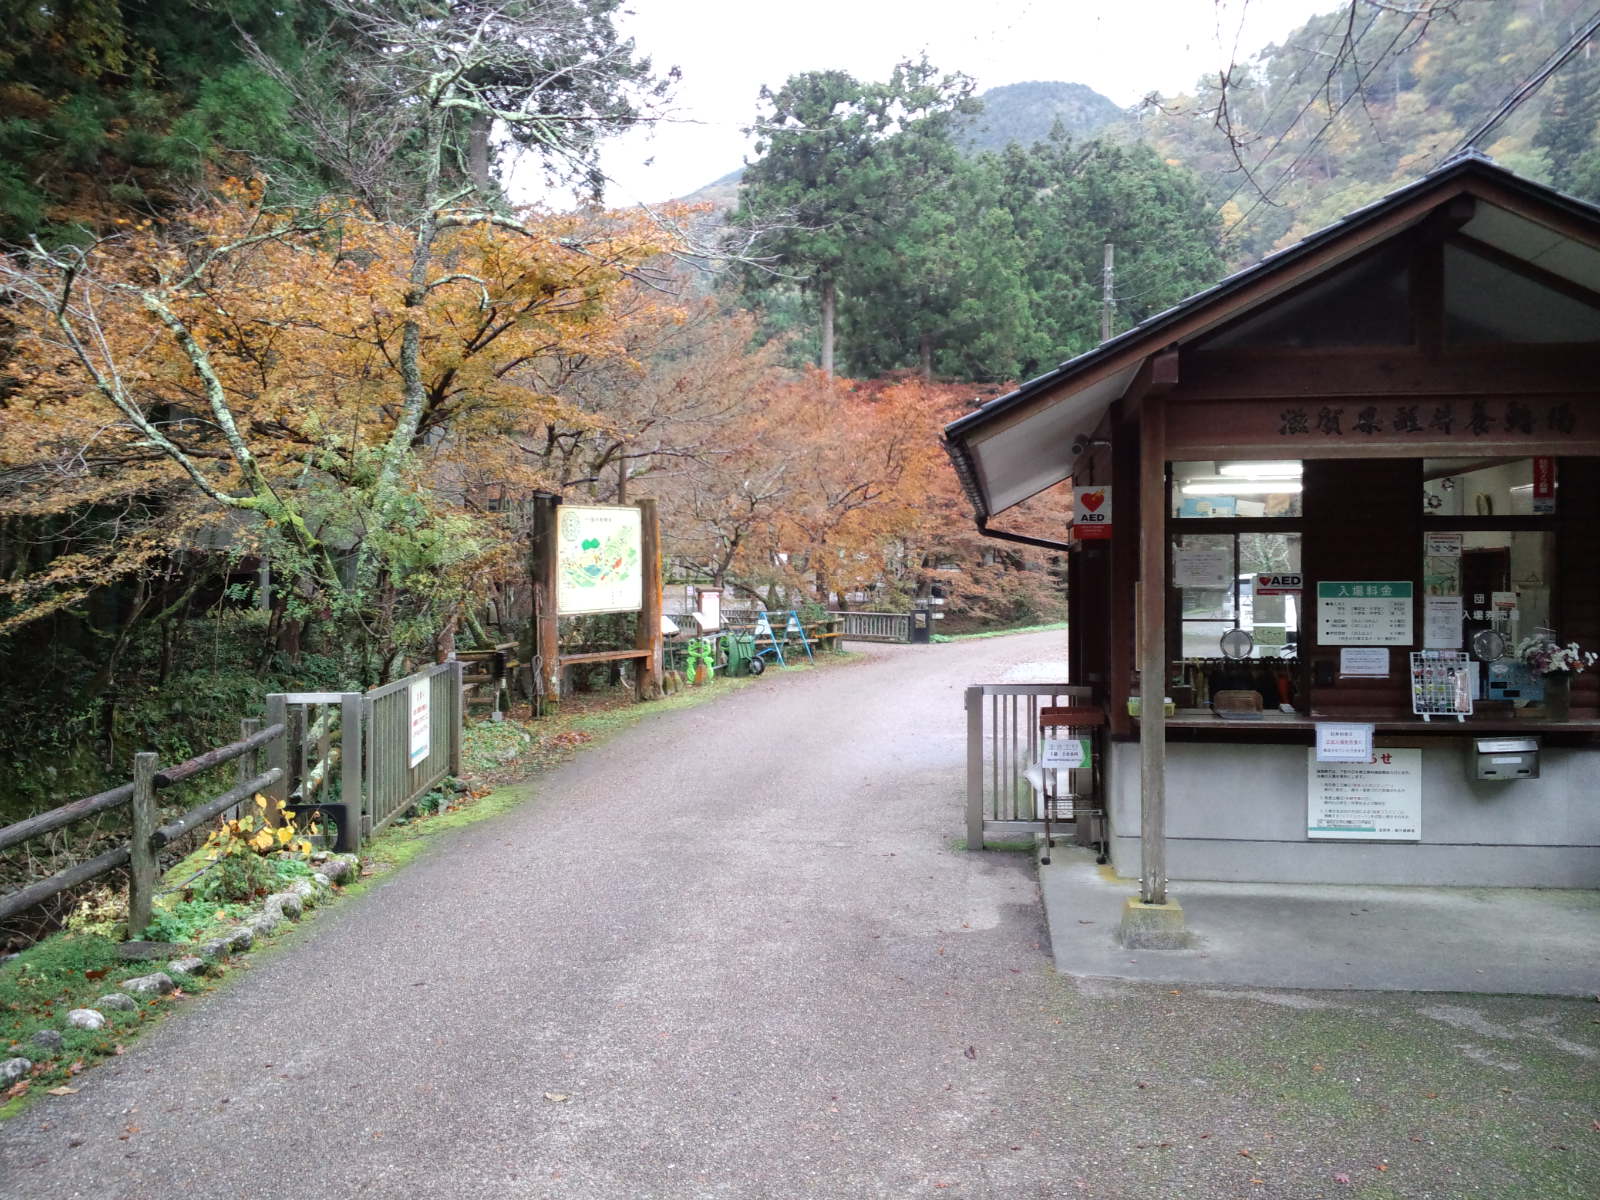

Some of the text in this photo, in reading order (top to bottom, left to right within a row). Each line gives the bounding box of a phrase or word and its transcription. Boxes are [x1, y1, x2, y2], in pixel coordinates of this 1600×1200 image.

[1080, 513, 1105, 522] AED
[1271, 576, 1301, 586] AED
[1338, 585, 1392, 597] 入場料金
